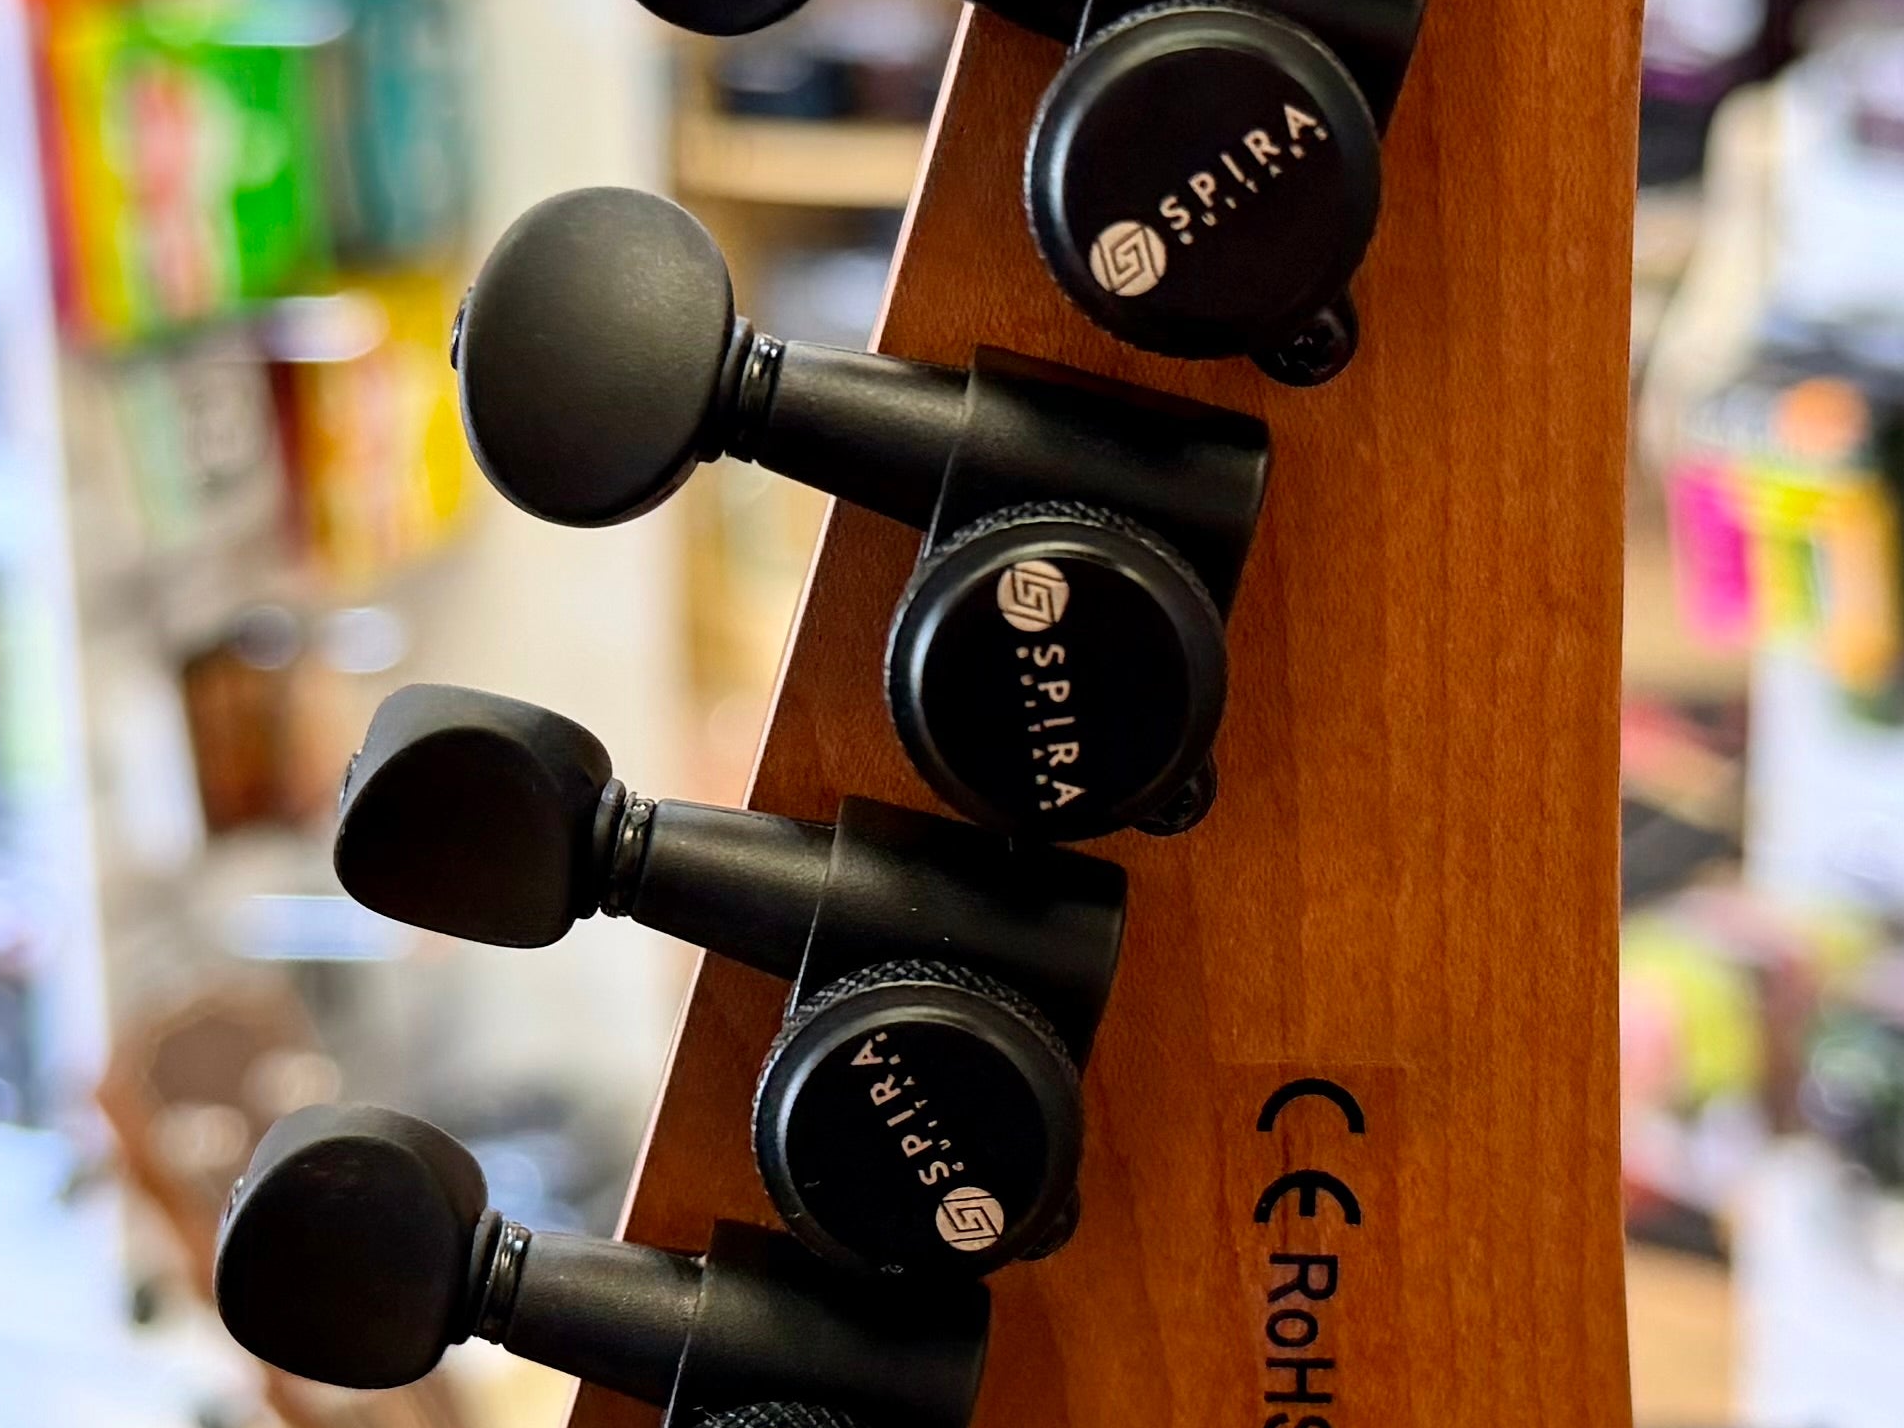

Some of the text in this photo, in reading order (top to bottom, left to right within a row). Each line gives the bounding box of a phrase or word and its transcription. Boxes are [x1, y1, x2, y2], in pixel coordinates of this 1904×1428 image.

[1159, 104, 1318, 232] SPIRA
[1033, 644, 1087, 808] SPIRA
[851, 1038, 950, 1185] SPIRA
